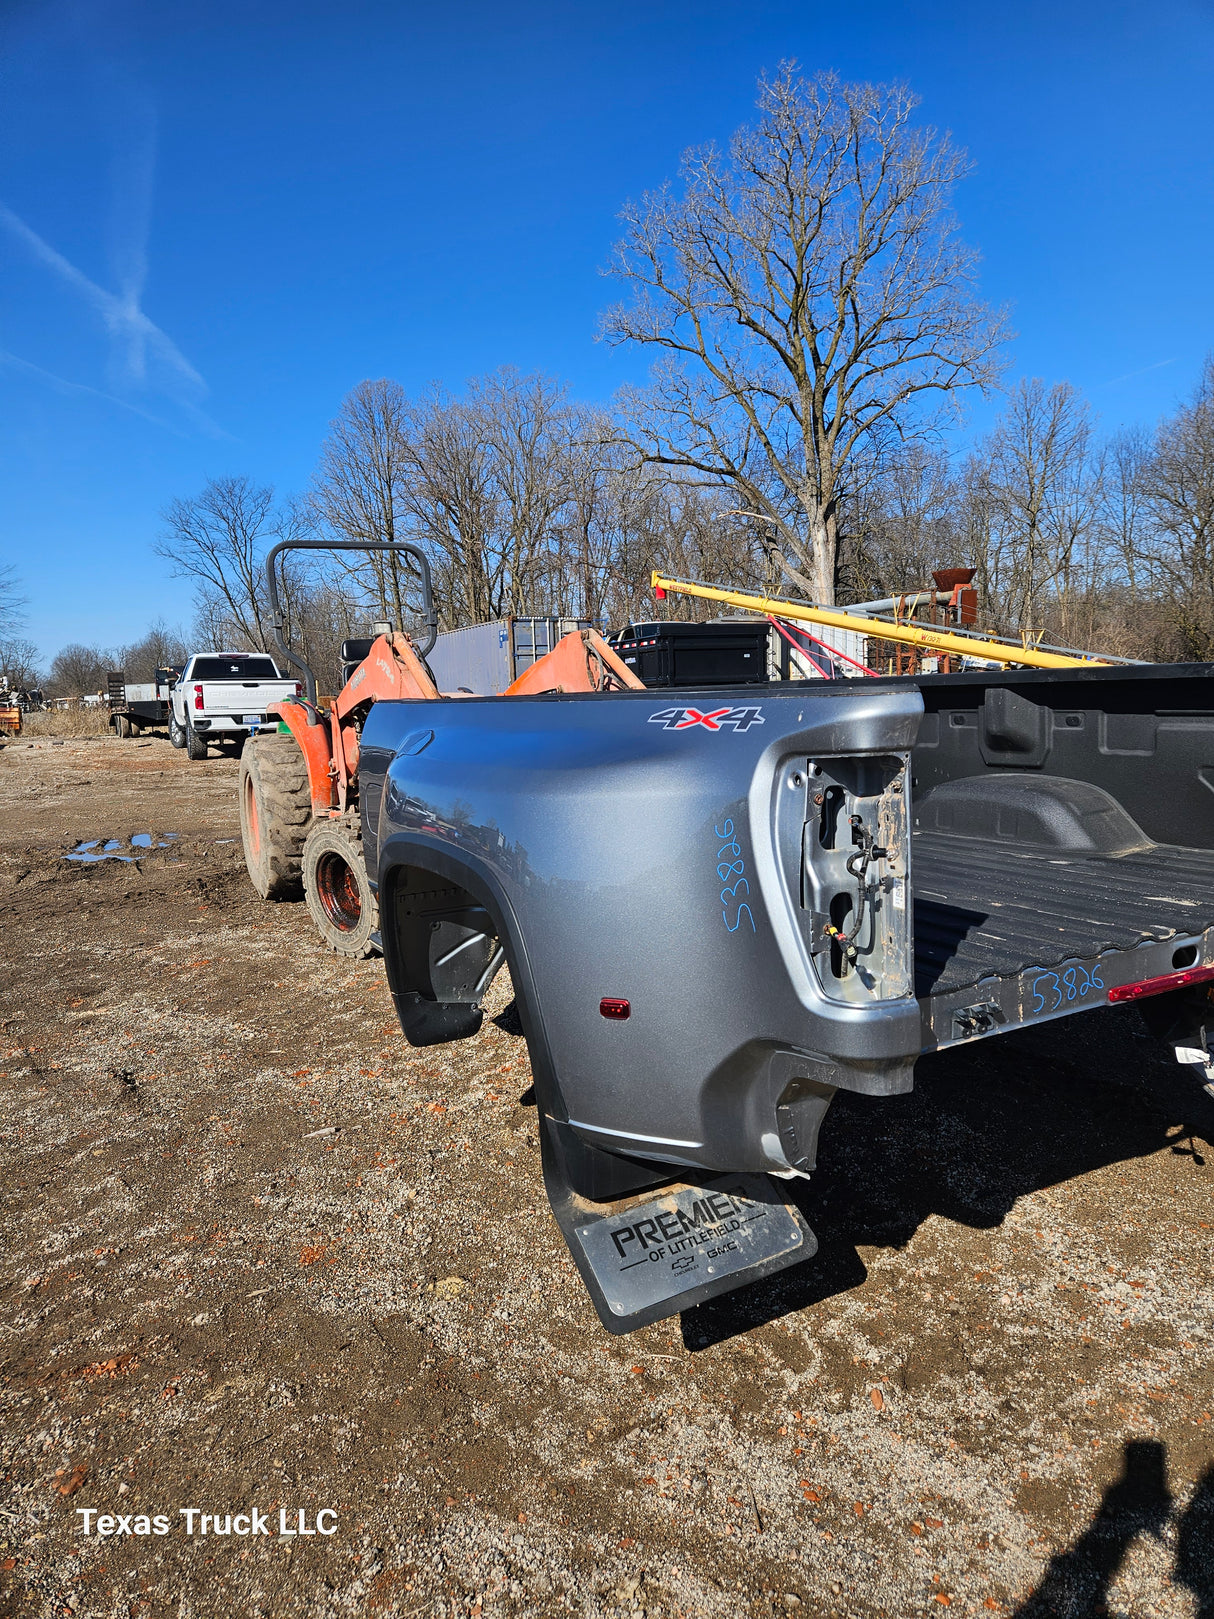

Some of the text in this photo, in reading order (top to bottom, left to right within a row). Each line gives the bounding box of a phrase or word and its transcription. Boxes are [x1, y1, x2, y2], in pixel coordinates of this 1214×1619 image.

[715, 818, 756, 933] 53826
[1033, 964, 1104, 1013] 53826
[610, 1186, 756, 1258] PREMIER
[649, 1219, 741, 1262] OF LITTLEFIELD
[706, 1241, 738, 1259] GMC
